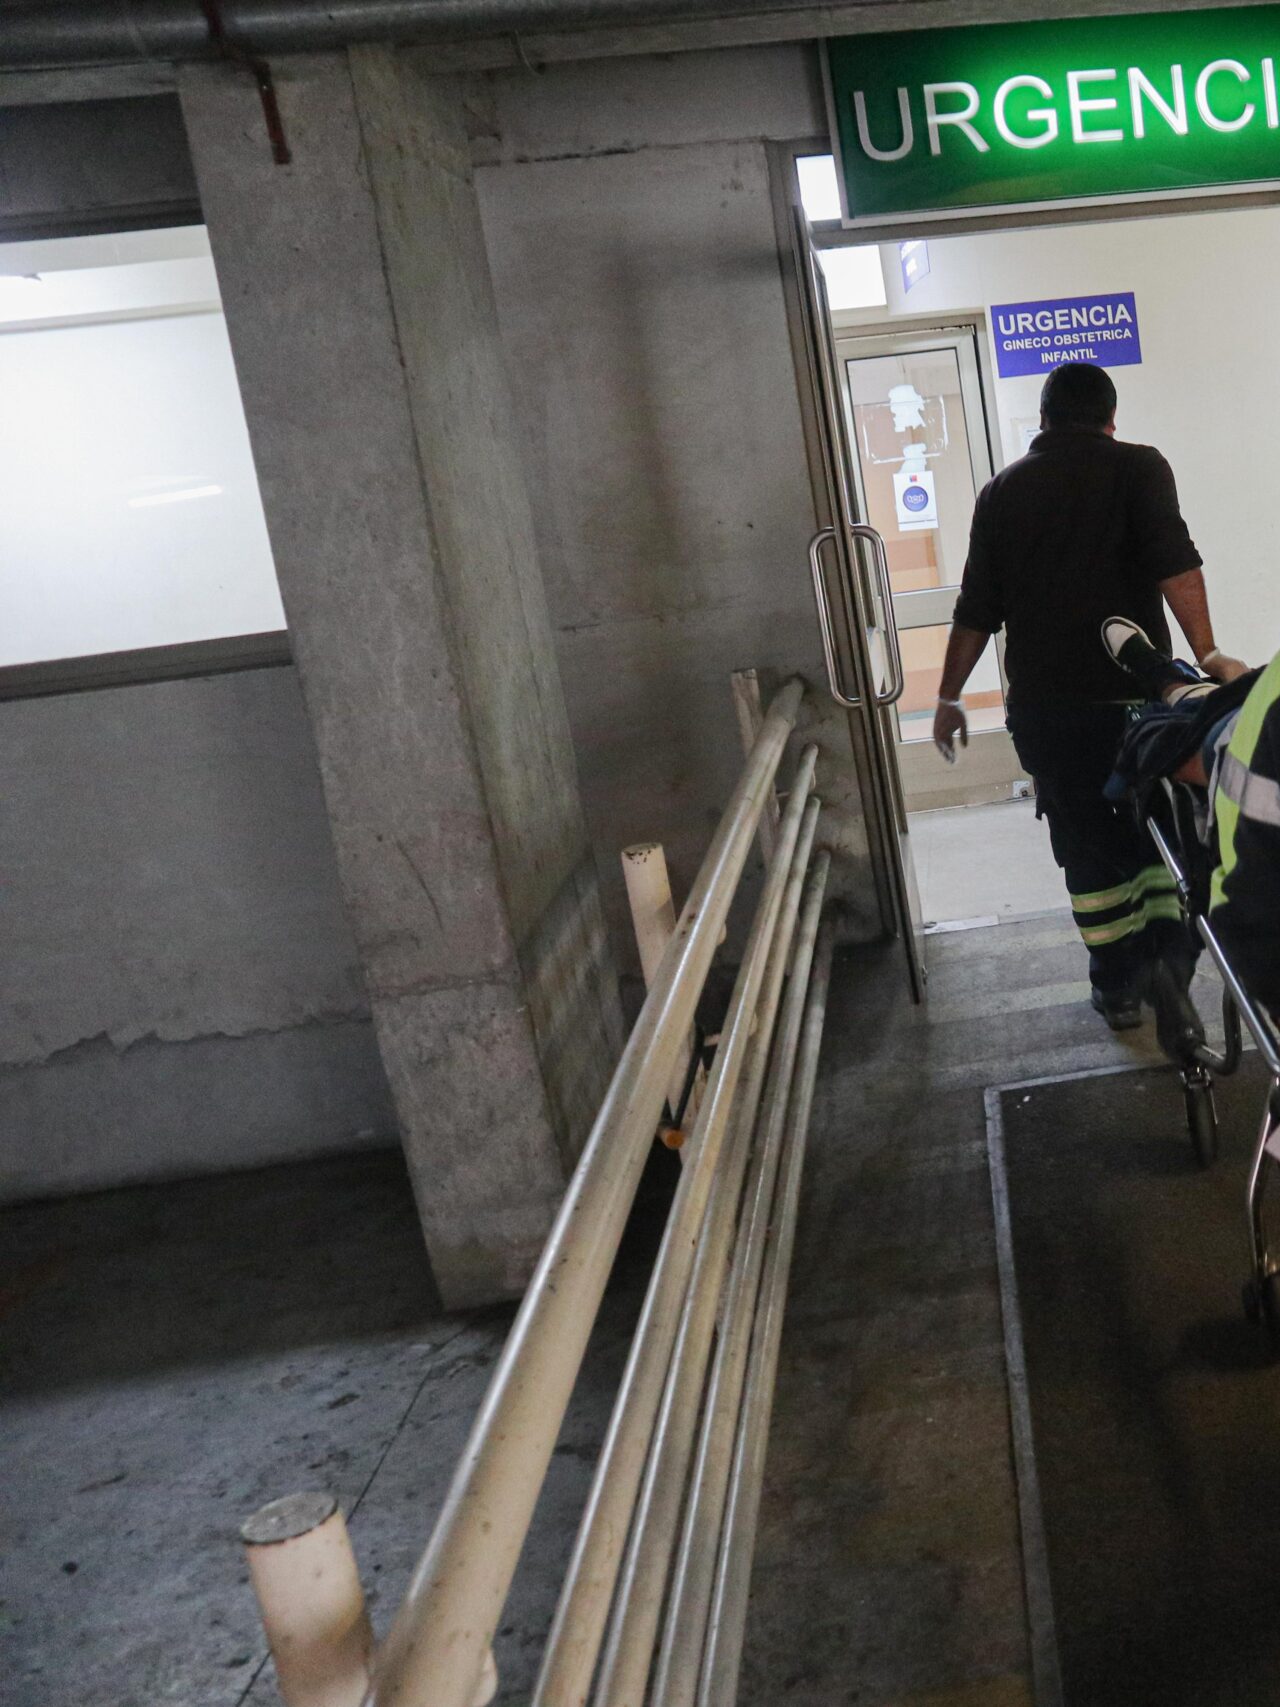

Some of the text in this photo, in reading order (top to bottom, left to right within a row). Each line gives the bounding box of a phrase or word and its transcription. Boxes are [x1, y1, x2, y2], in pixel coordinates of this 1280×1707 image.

[998, 303, 1133, 336] URGENCIA
[1003, 328, 1132, 351] GINECO OBSTETRICA
[1040, 348, 1098, 364] INFANTIL
